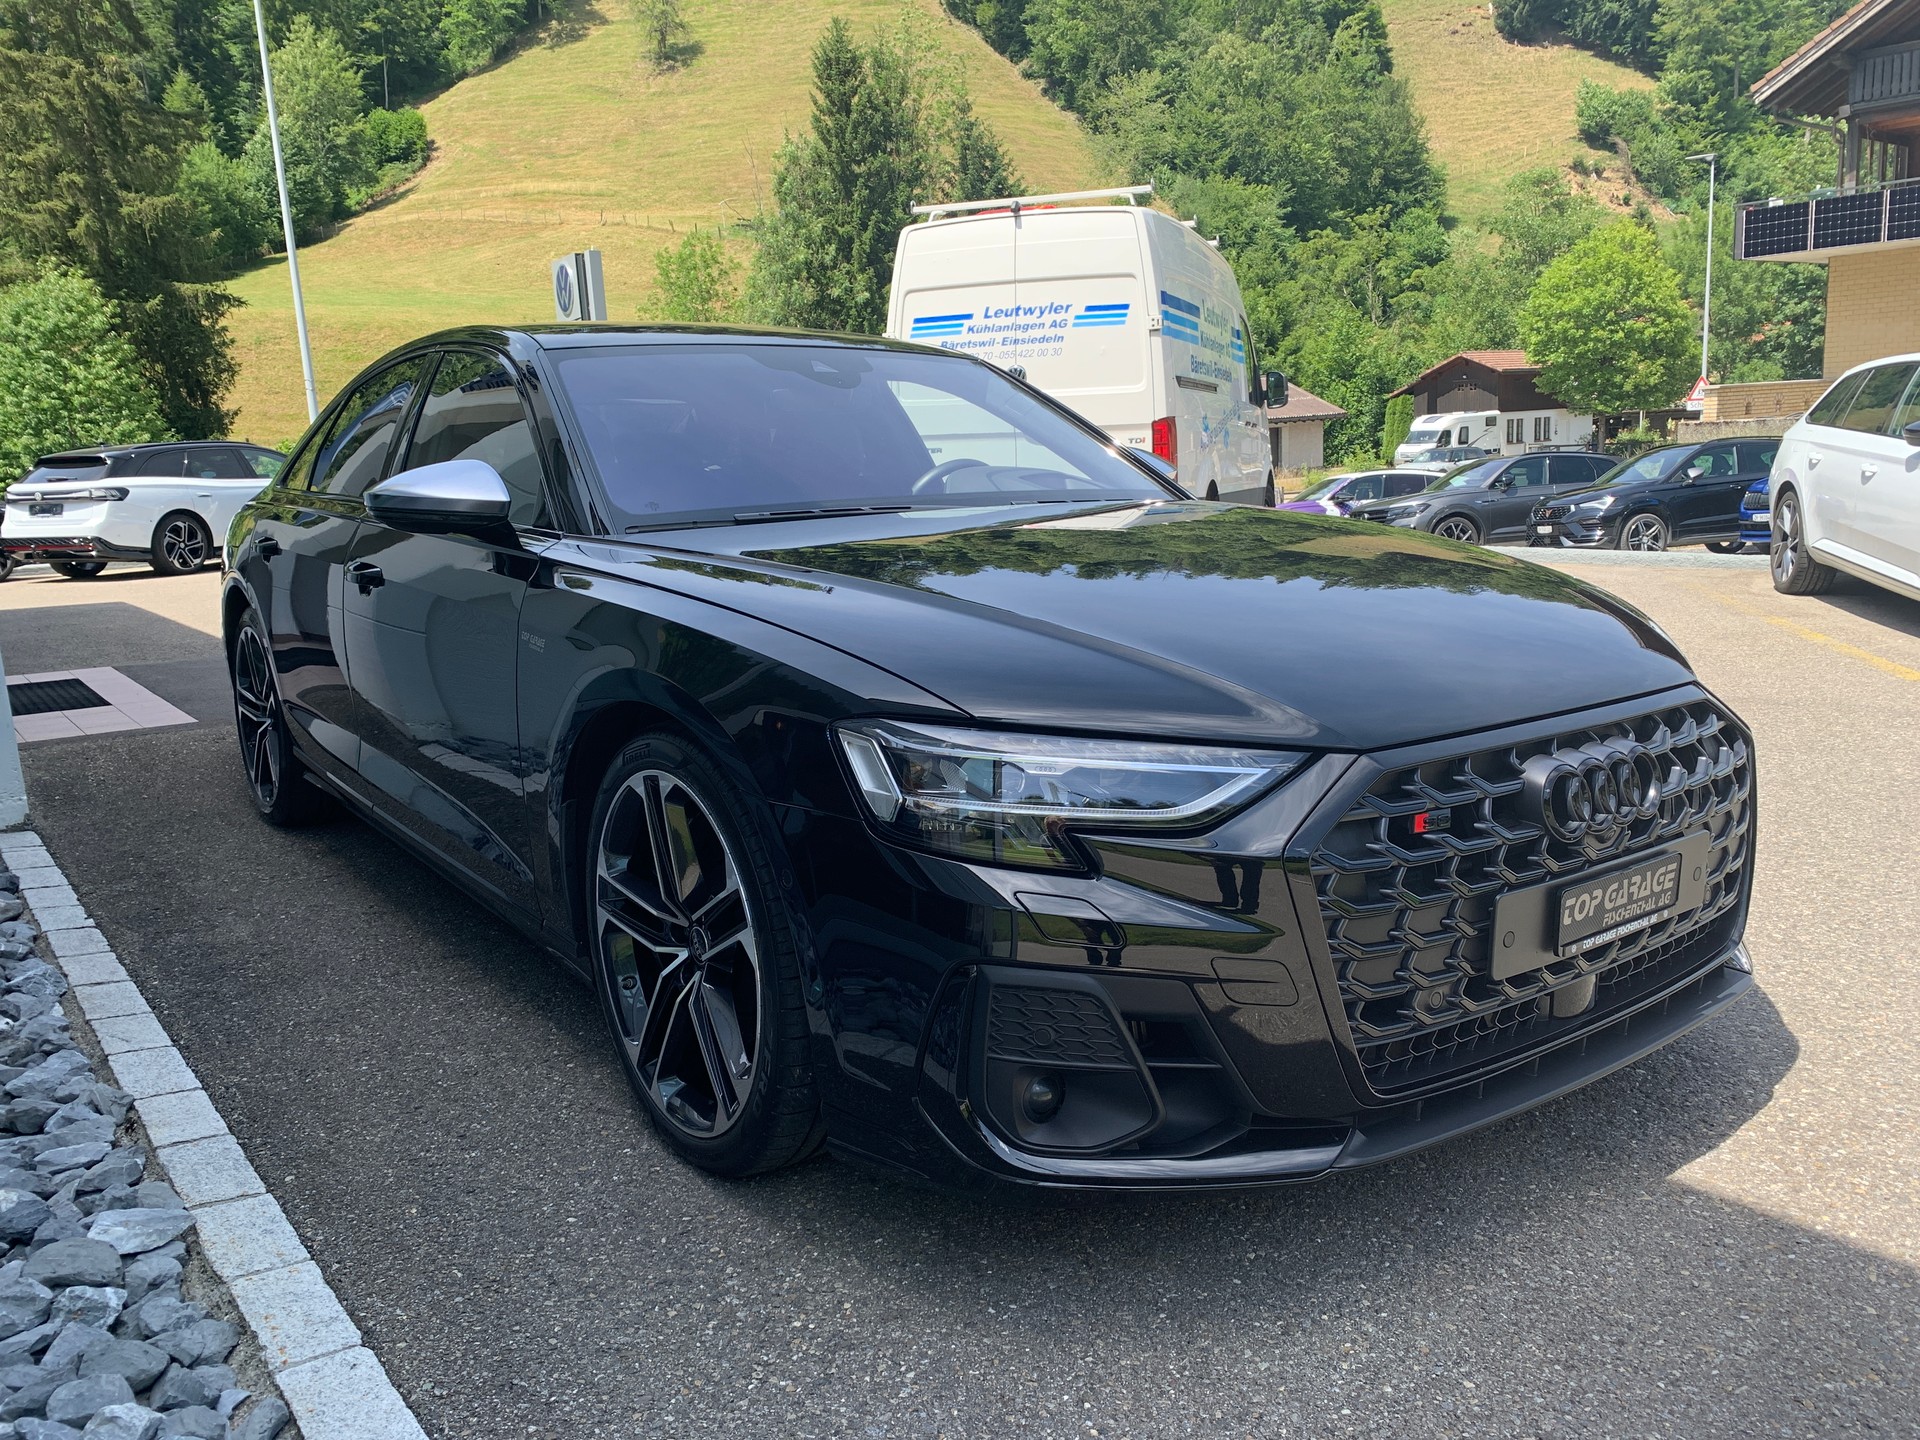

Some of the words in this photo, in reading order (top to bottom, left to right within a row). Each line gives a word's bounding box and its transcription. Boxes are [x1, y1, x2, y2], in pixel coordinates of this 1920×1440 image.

[983, 302, 1073, 319] Leutwyler
[967, 322, 1045, 335] Kühlanlagen
[1049, 318, 1069, 329] AG
[982, 351, 993, 360] 70
[1018, 348, 1035, 358] 422
[1037, 348, 1049, 357] 00
[1051, 347, 1063, 356] 30
[622, 742, 651, 766] PIRELLI
[1563, 888, 1602, 925] TOP
[1604, 862, 1678, 910] GARAGE
[1603, 896, 1656, 927] FISCHENTHAL
[1658, 891, 1672, 907] AG
[1583, 938, 1594, 949] TOP
[1595, 929, 1617, 945] GARAGE
